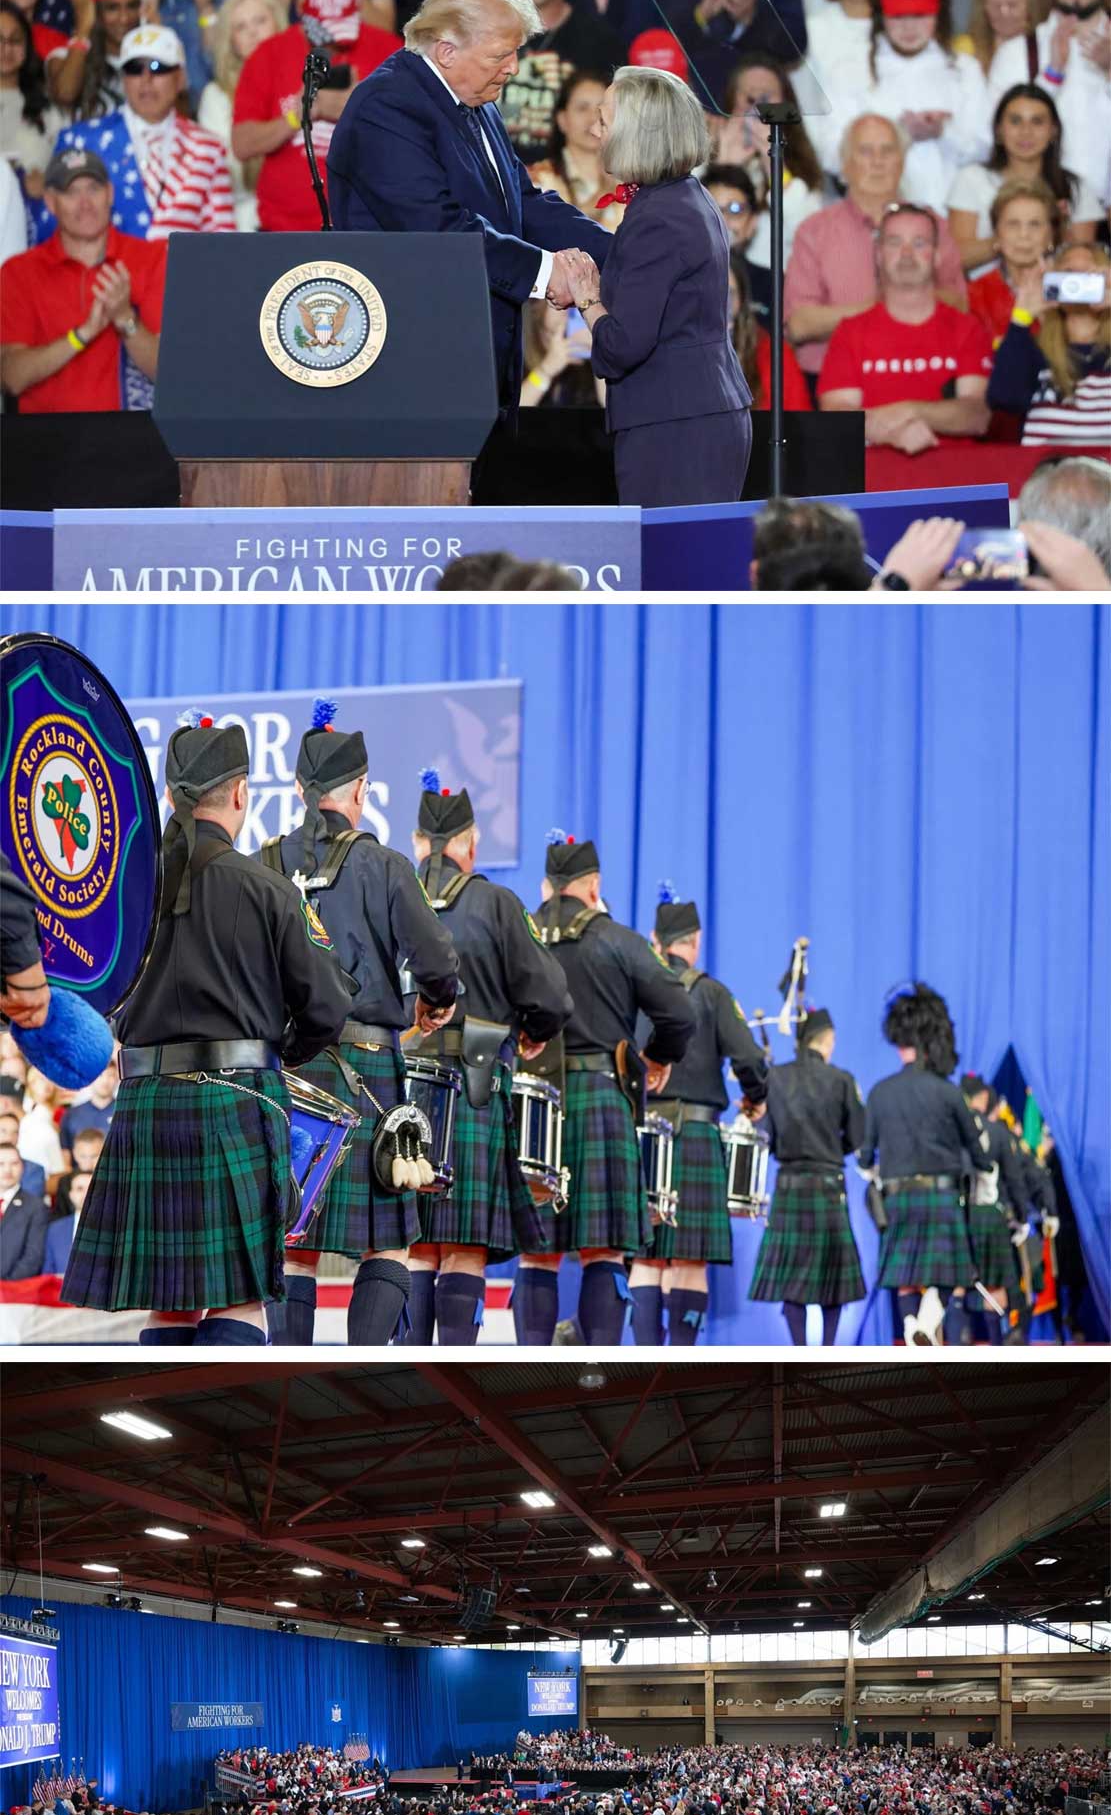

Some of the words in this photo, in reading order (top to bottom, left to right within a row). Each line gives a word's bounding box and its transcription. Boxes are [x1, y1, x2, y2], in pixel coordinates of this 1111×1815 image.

[324, 267, 337, 276] OF
[264, 266, 321, 321] PRESIDENT
[357, 281, 382, 332] UNITED
[281, 358, 312, 380] SEAL
[335, 342, 377, 380] STATES
[236, 538, 388, 559] FIGHTING
[404, 538, 464, 558] FOR
[21, 726, 85, 779] Rockland
[89, 757, 111, 853] County
[46, 787, 87, 837] Police
[17, 795, 55, 894] Emerald
[59, 865, 107, 905] Society
[53, 919, 94, 968] Drums
[21, 1654, 51, 1688] YORK
[5, 1689, 42, 1711] WELCOMES
[198, 1705, 230, 1716] FIGHTING
[231, 1705, 244, 1715] FOR
[31, 1723, 56, 1747] TRUMP
[187, 1716, 223, 1728] AMERICAN
[223, 1715, 254, 1726] WORKERS
